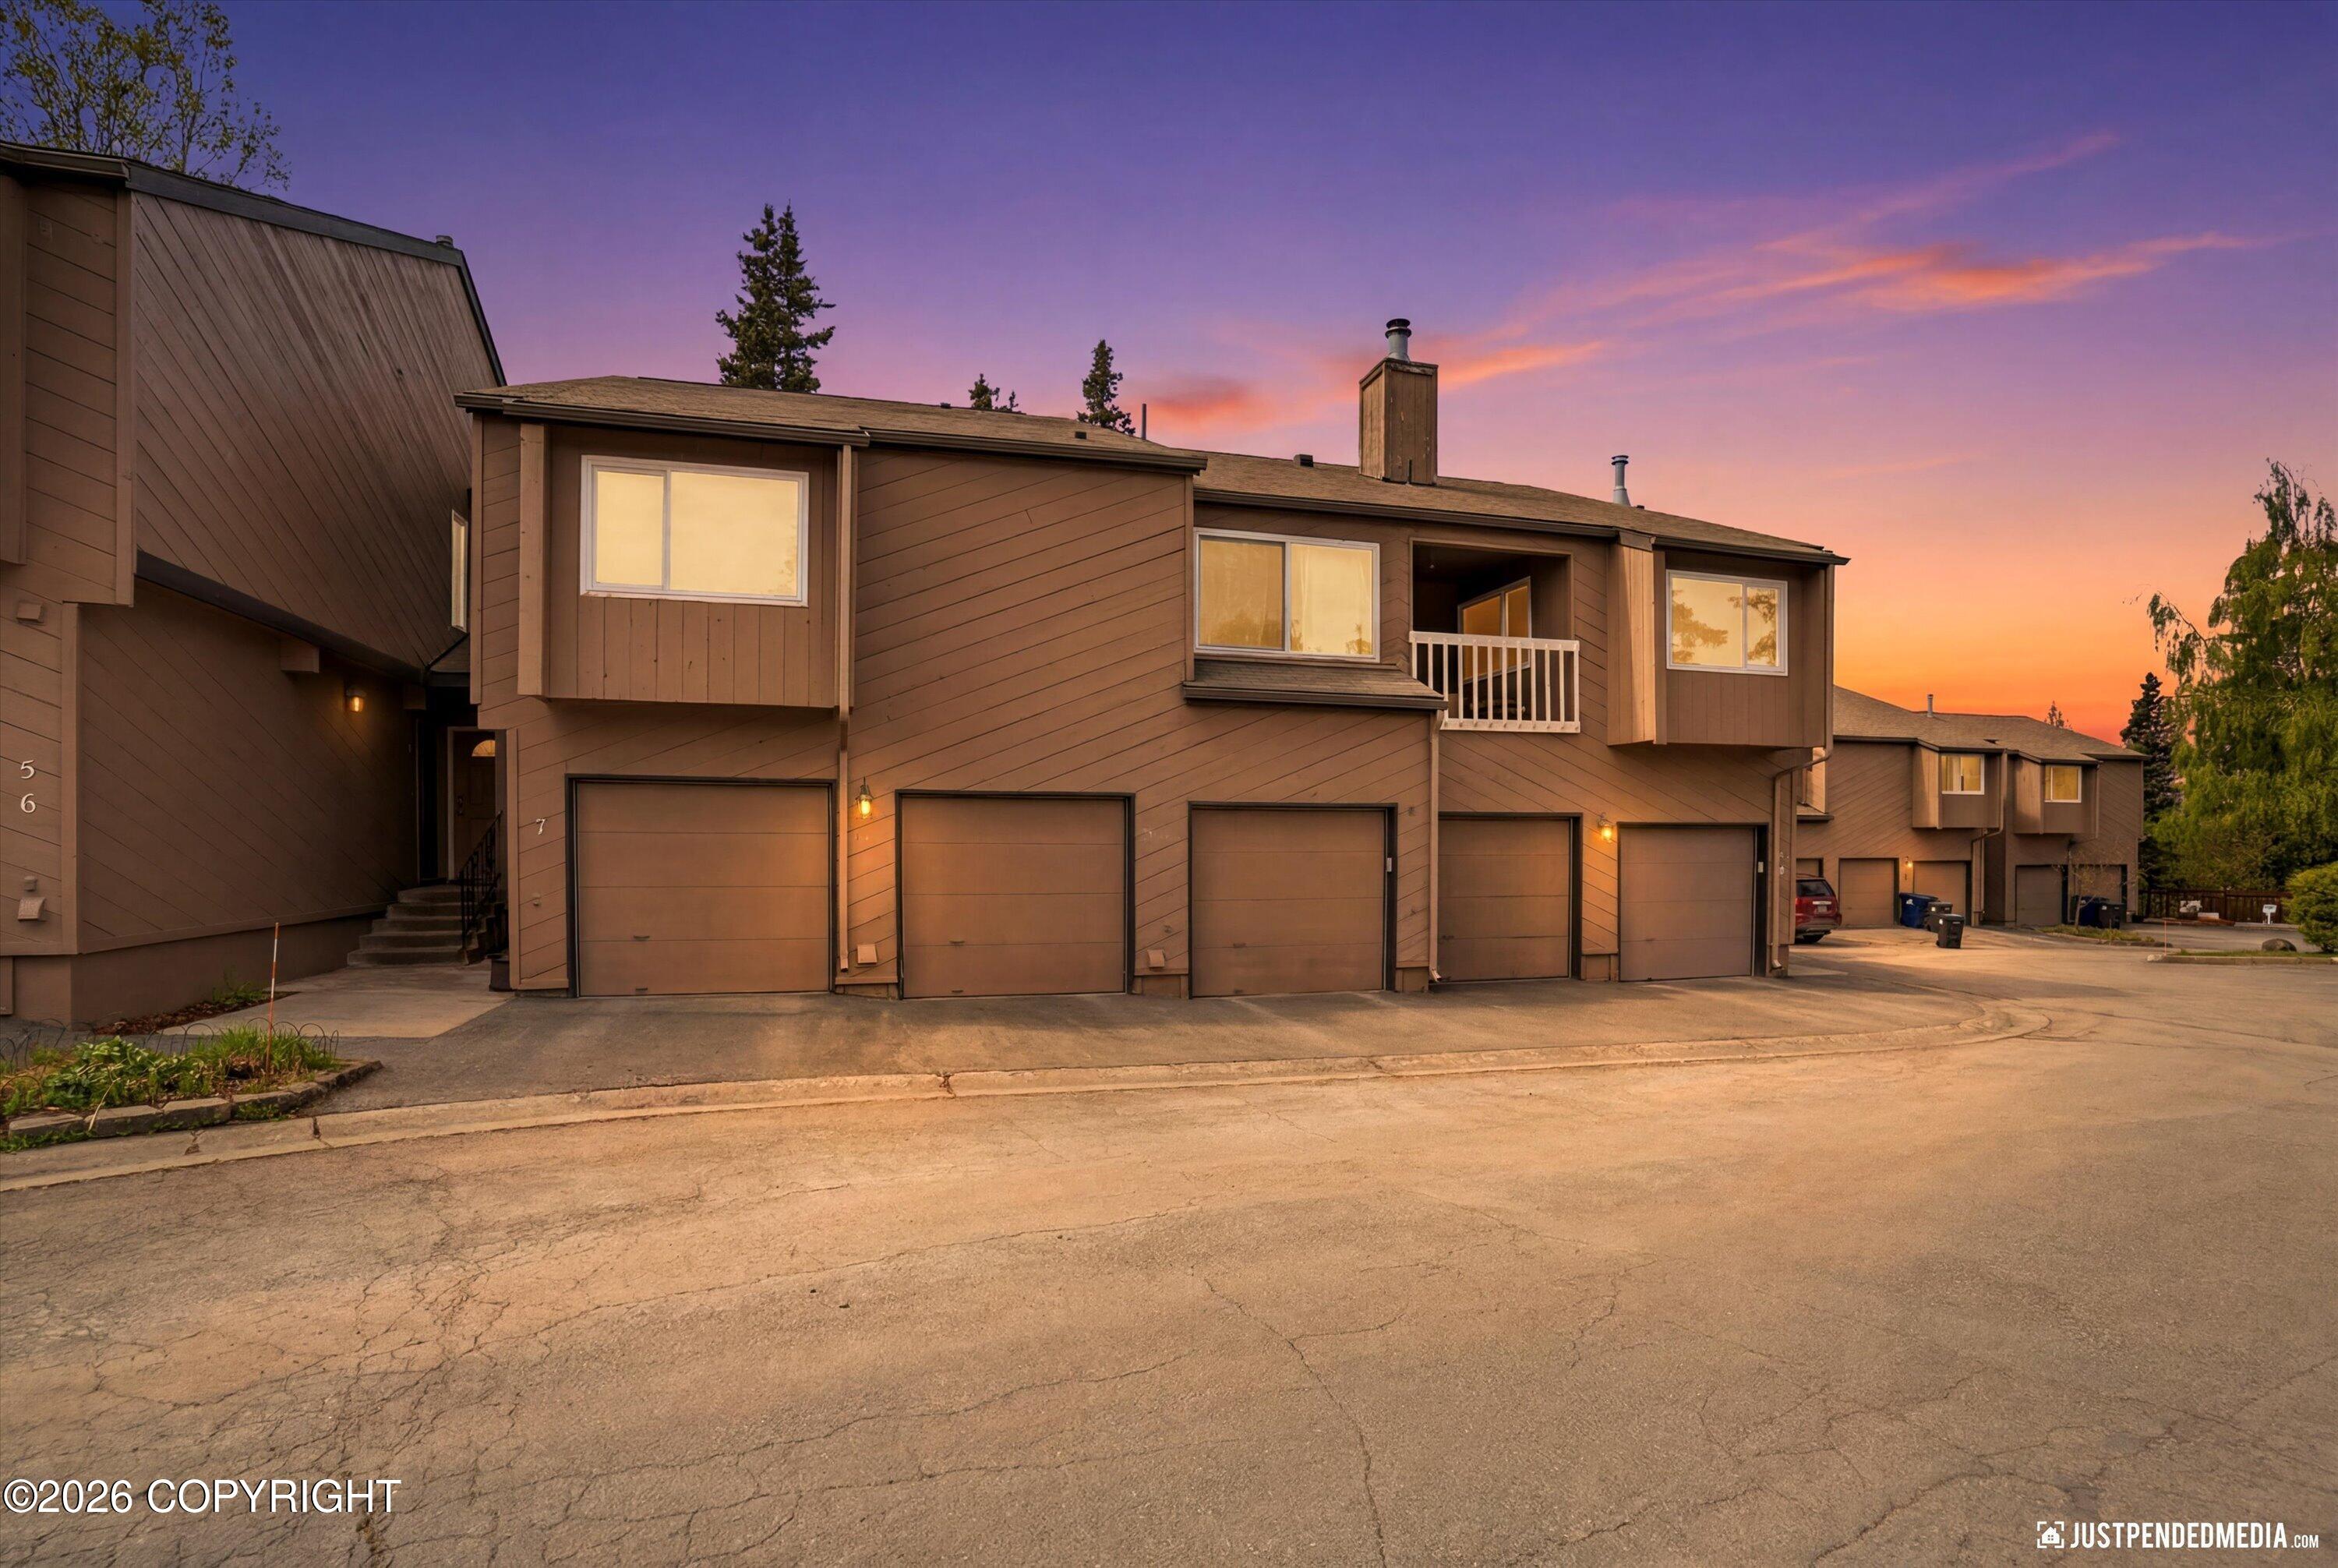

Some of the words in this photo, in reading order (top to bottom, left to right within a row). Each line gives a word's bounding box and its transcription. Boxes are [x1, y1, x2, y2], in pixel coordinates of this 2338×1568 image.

[20, 759, 35, 779] 5
[20, 793, 36, 813] 6
[535, 818, 546, 835] 7
